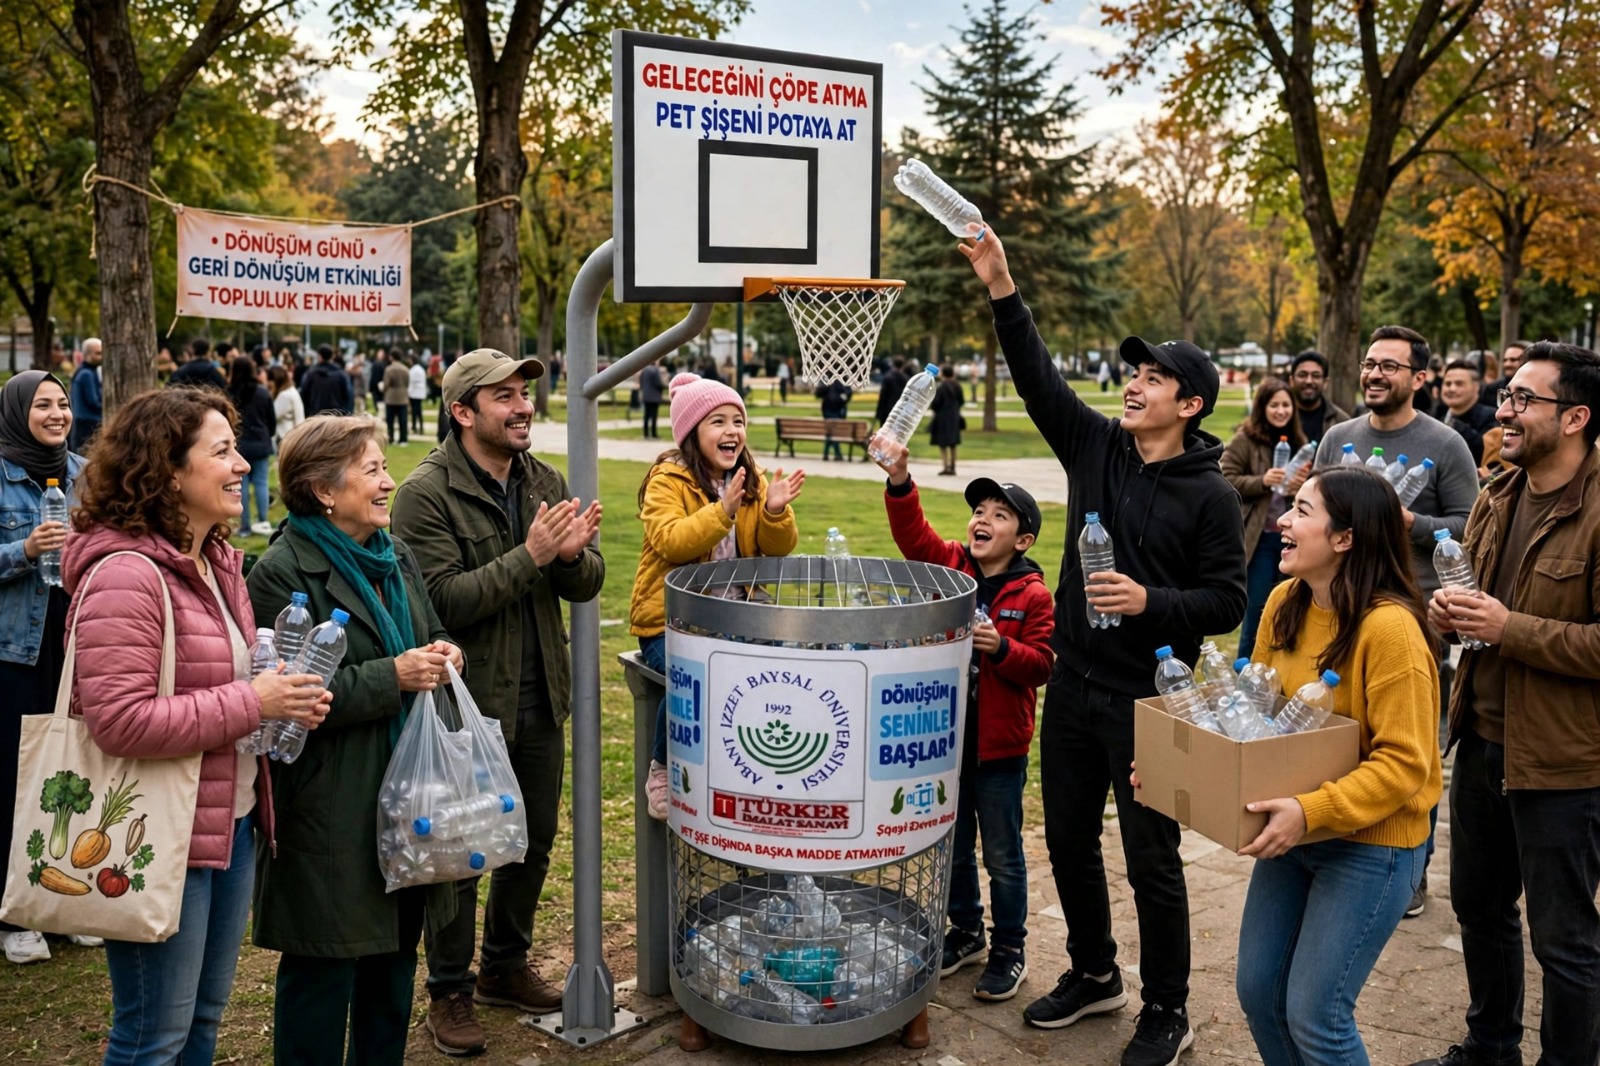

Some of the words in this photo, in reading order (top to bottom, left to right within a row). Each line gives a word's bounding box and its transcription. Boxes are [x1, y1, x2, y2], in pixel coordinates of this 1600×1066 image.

[642, 63, 764, 98] GELECEĞİNİ
[769, 72, 818, 108] ÇÖPE
[822, 83, 867, 108] ATMA
[656, 101, 695, 129] PET
[701, 99, 762, 141] ŞİŞENİ
[768, 112, 833, 140] POTAYA
[837, 119, 857, 141] AT
[225, 230, 312, 259] DÖNÜŞÜM
[317, 237, 364, 259] GÜNÜ
[188, 256, 229, 278] GERİ
[234, 259, 320, 286] DÖNÜŞÜM
[325, 264, 401, 286] ETKİNLİĞİ
[207, 286, 298, 310] TOPLULUK
[303, 290, 382, 312] ETKİNLİĞİ
[881, 680, 949, 706] DÖNÜŞÜM
[765, 703, 792, 715] 1992
[880, 705, 949, 738] SENİNLE
[723, 737, 763, 785] ABANT
[746, 671, 813, 691] BAYSAL
[879, 737, 947, 769] BAŞLAR
[738, 797, 849, 819] TÜRKER
[755, 844, 793, 859] BAŞKA
[797, 849, 841, 860] MADDE
[844, 846, 906, 860] ATMAYINIZ
